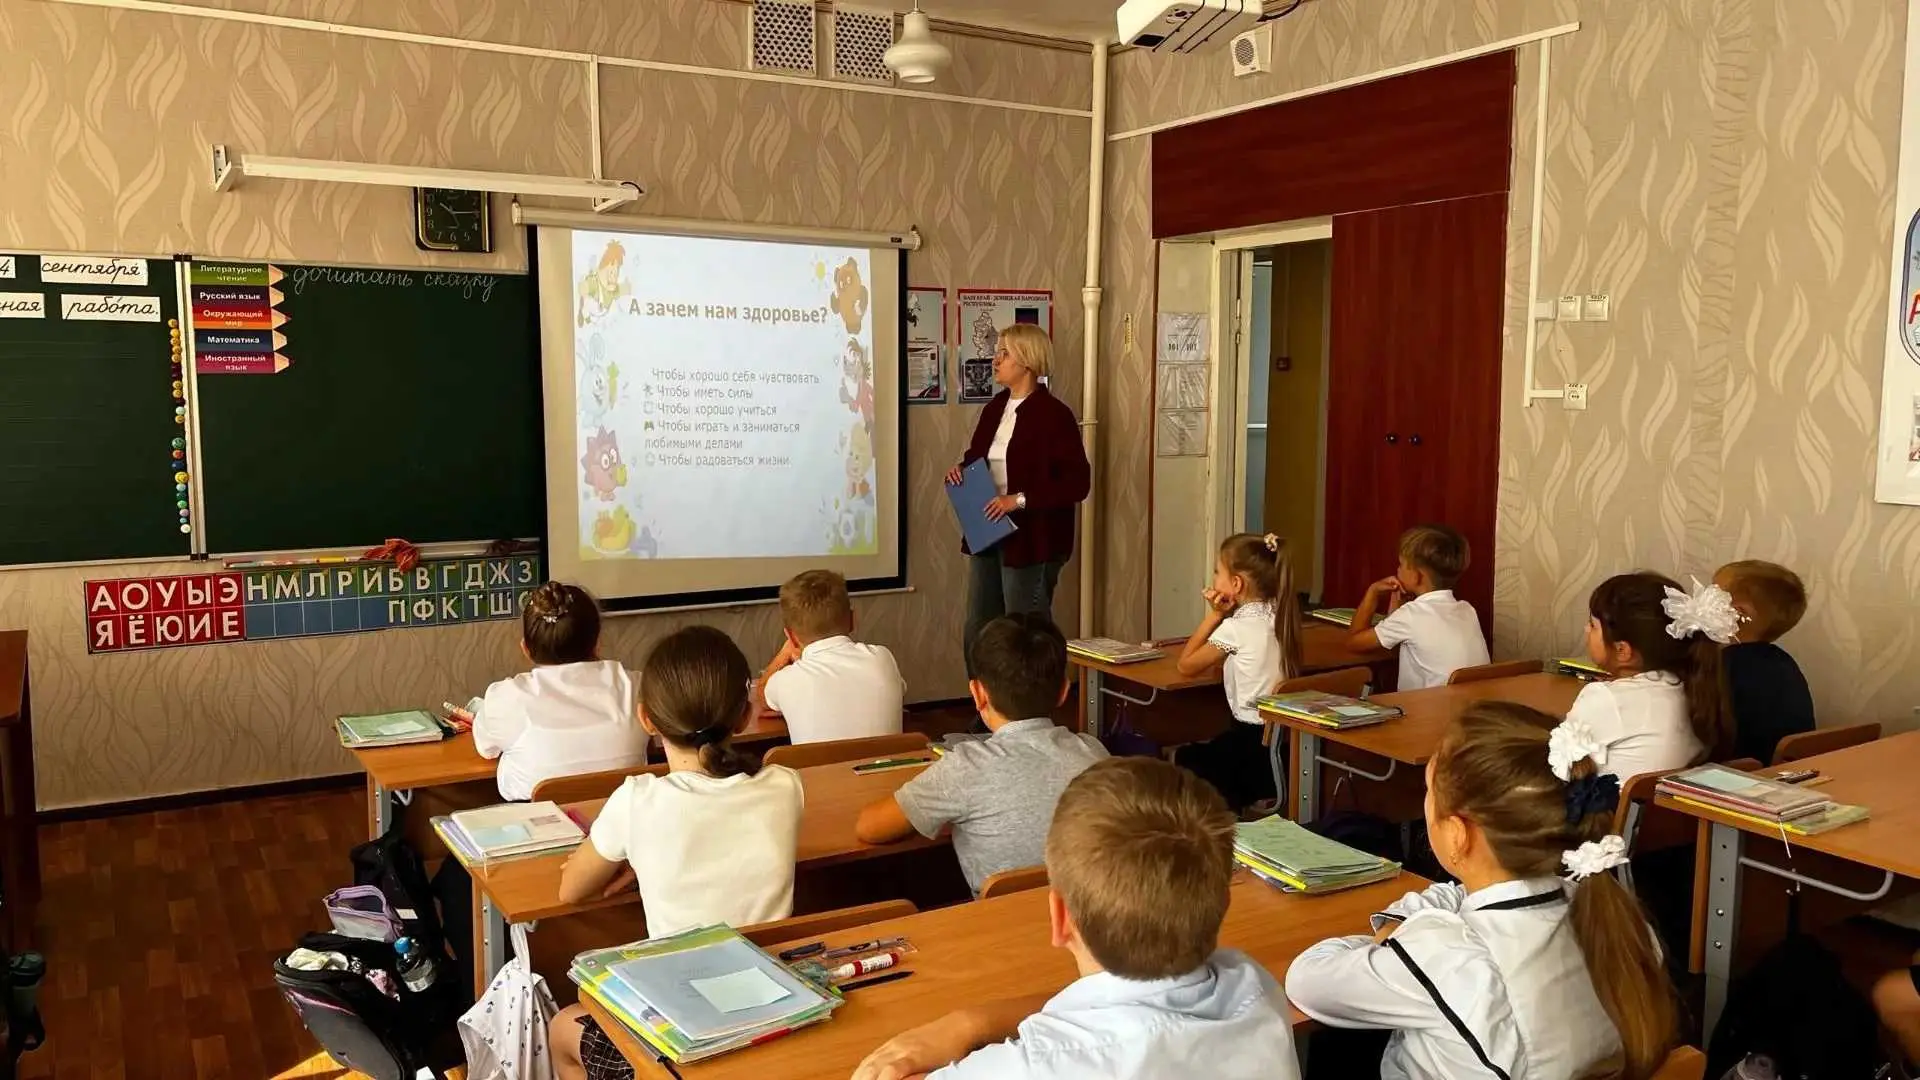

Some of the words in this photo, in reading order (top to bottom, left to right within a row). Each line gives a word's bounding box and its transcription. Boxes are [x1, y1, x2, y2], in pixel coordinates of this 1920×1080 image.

[200, 264, 262, 274] Литературное
[293, 267, 413, 295] дочитать
[424, 271, 499, 302] сказку
[199, 291, 237, 300] Русский
[203, 309, 263, 318] Окружающий
[628, 298, 641, 316] А
[646, 301, 698, 318] зачем
[705, 303, 737, 320] нам
[743, 306, 828, 325] здоровье?
[207, 335, 260, 344] Математика
[204, 354, 267, 363] Иностранный
[652, 367, 685, 381] Чтобы
[689, 370, 729, 383] хорошо
[732, 370, 756, 382] себя
[759, 372, 820, 386] чувствовать
[657, 384, 689, 398] Чтобы
[694, 388, 725, 399] иметь
[727, 388, 753, 399] силы
[658, 401, 690, 415] Чтобы
[695, 404, 734, 416] хорошо
[737, 406, 777, 418] учиться
[658, 419, 690, 432] Чтобы
[695, 422, 729, 434] играть
[732, 423, 739, 432] и
[742, 422, 800, 433] заниматься
[645, 436, 701, 449] любимыми
[704, 438, 743, 450] делами
[658, 453, 692, 466] Чтобы
[696, 455, 754, 468] радоваться
